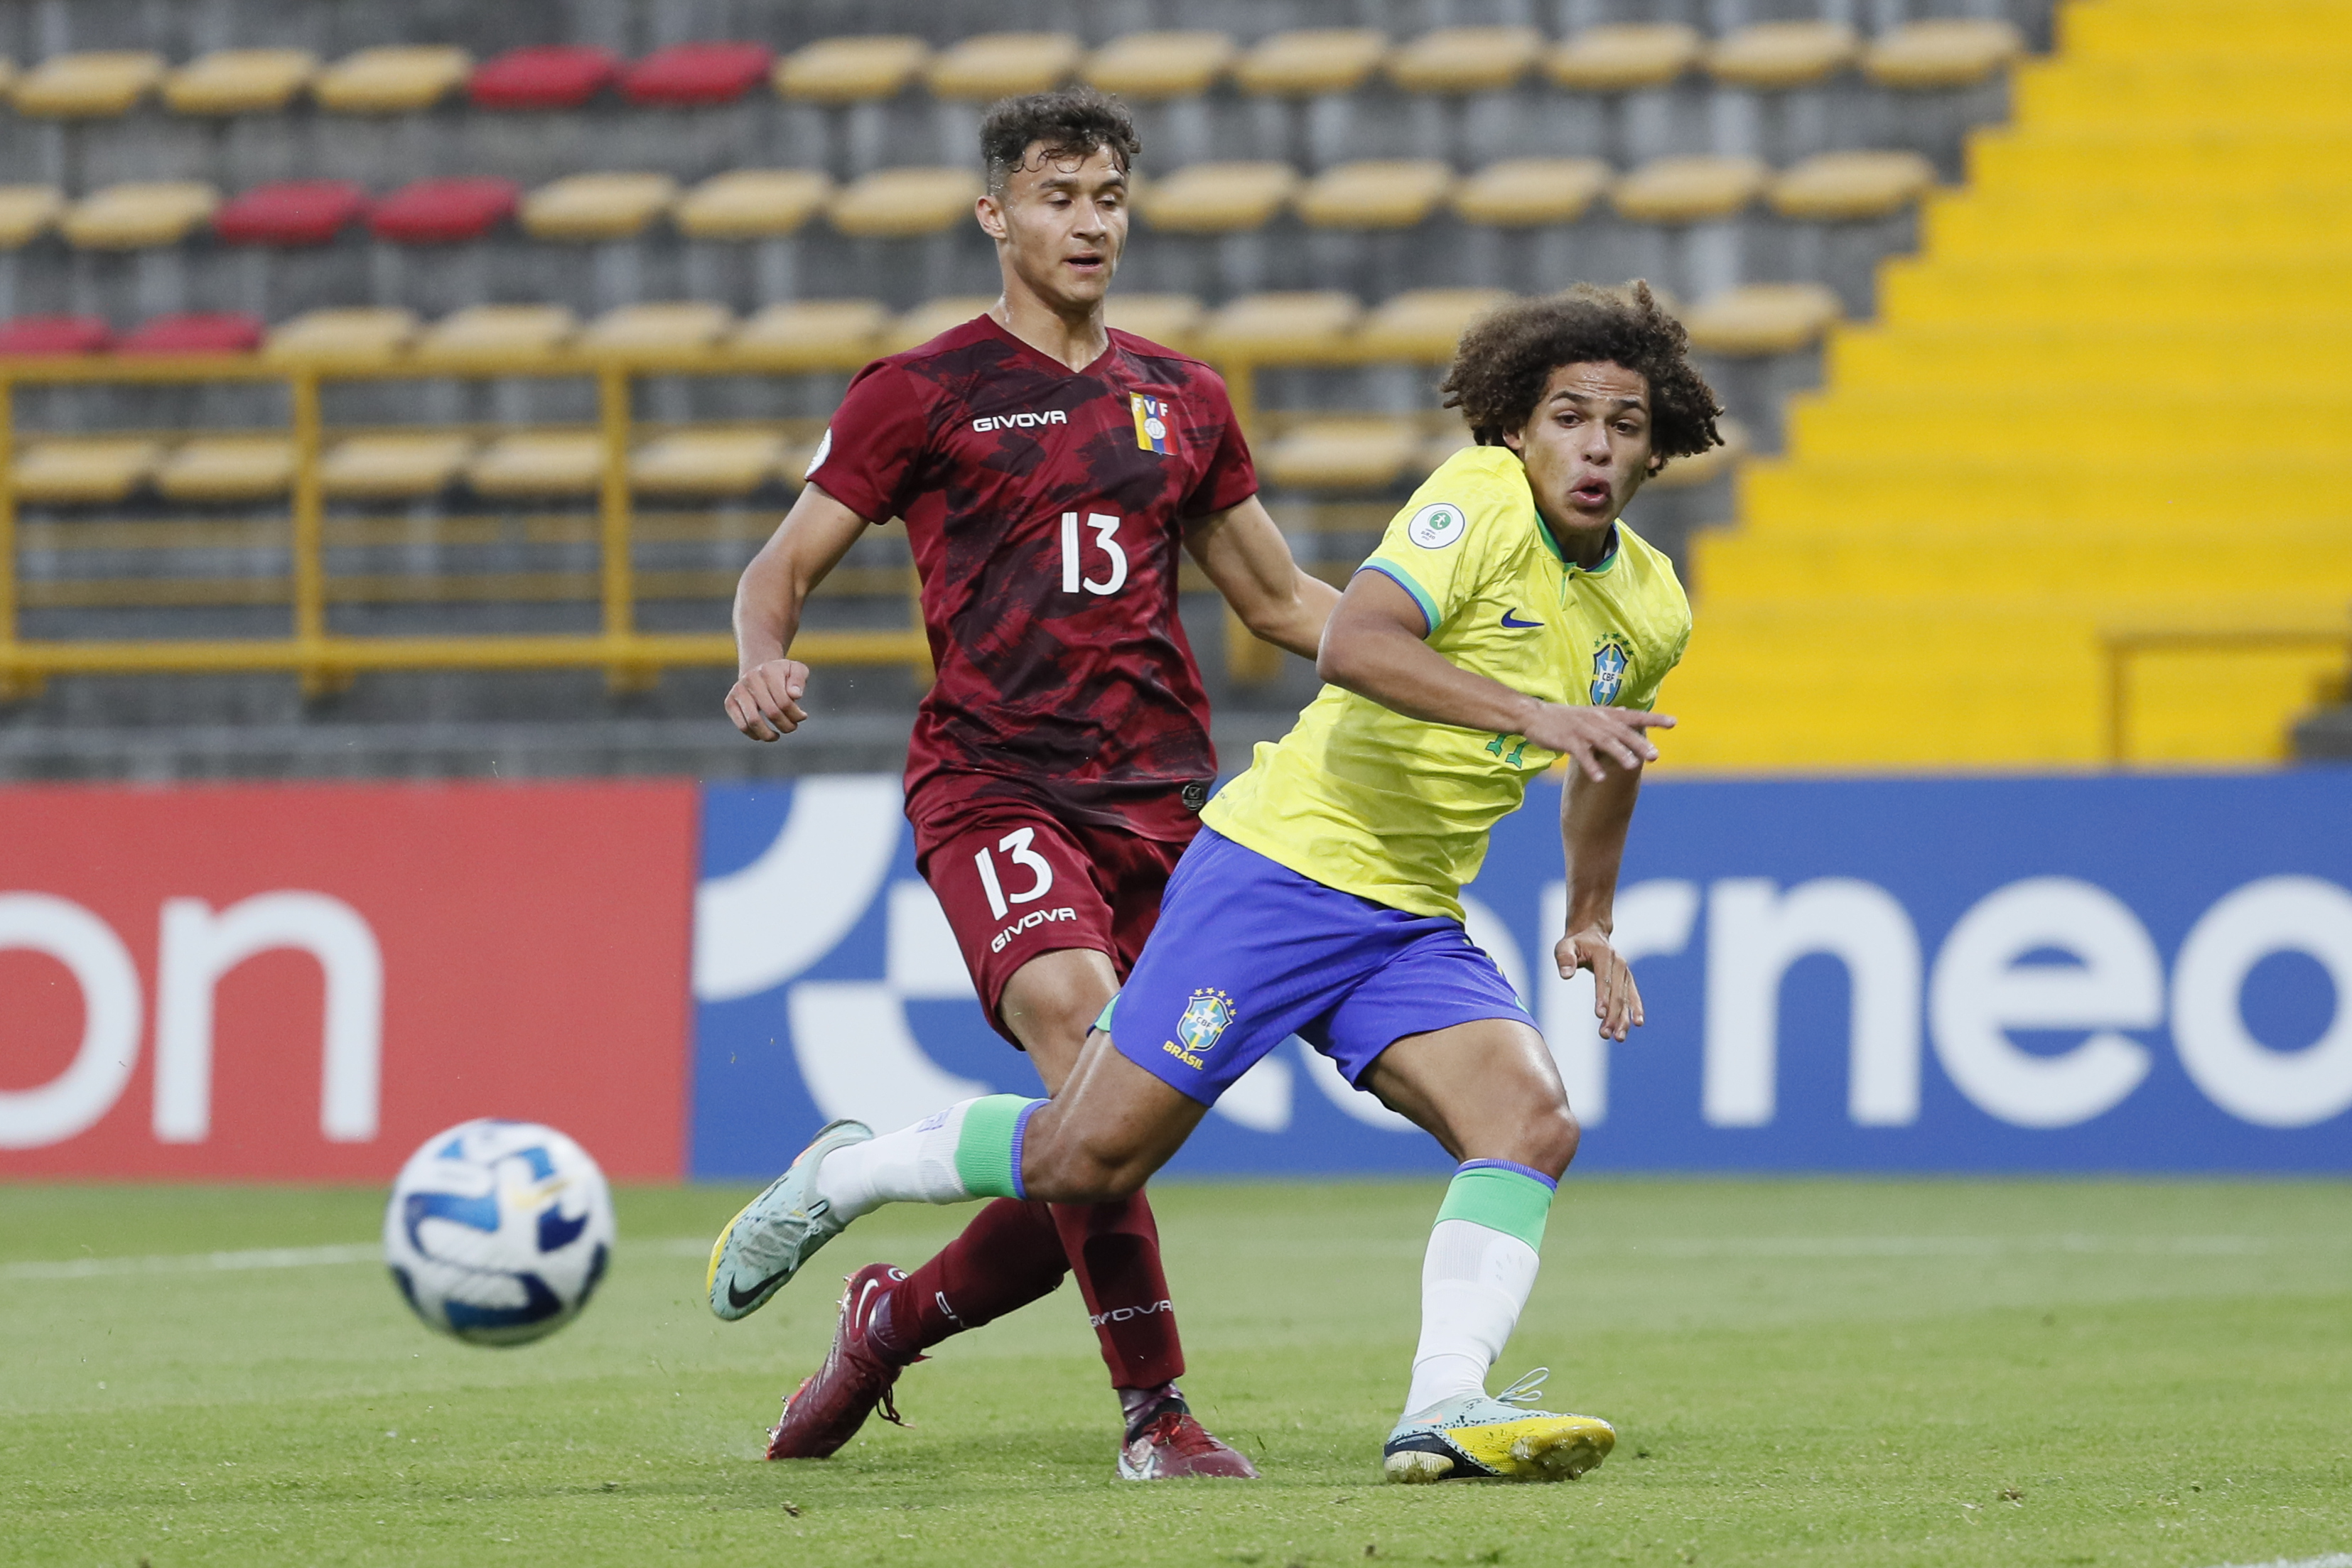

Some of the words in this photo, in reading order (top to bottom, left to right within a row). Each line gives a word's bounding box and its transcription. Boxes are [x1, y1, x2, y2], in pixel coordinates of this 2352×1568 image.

[1133, 397, 1169, 417] FVF
[973, 410, 1067, 432] GIVOVA
[1061, 512, 1129, 595] 13
[1602, 672, 1615, 681] CBF
[974, 827, 1054, 921] 13
[991, 907, 1077, 953] GIVOVA
[1196, 1017, 1212, 1028] CBF
[1162, 1040, 1204, 1071] BRASIL
